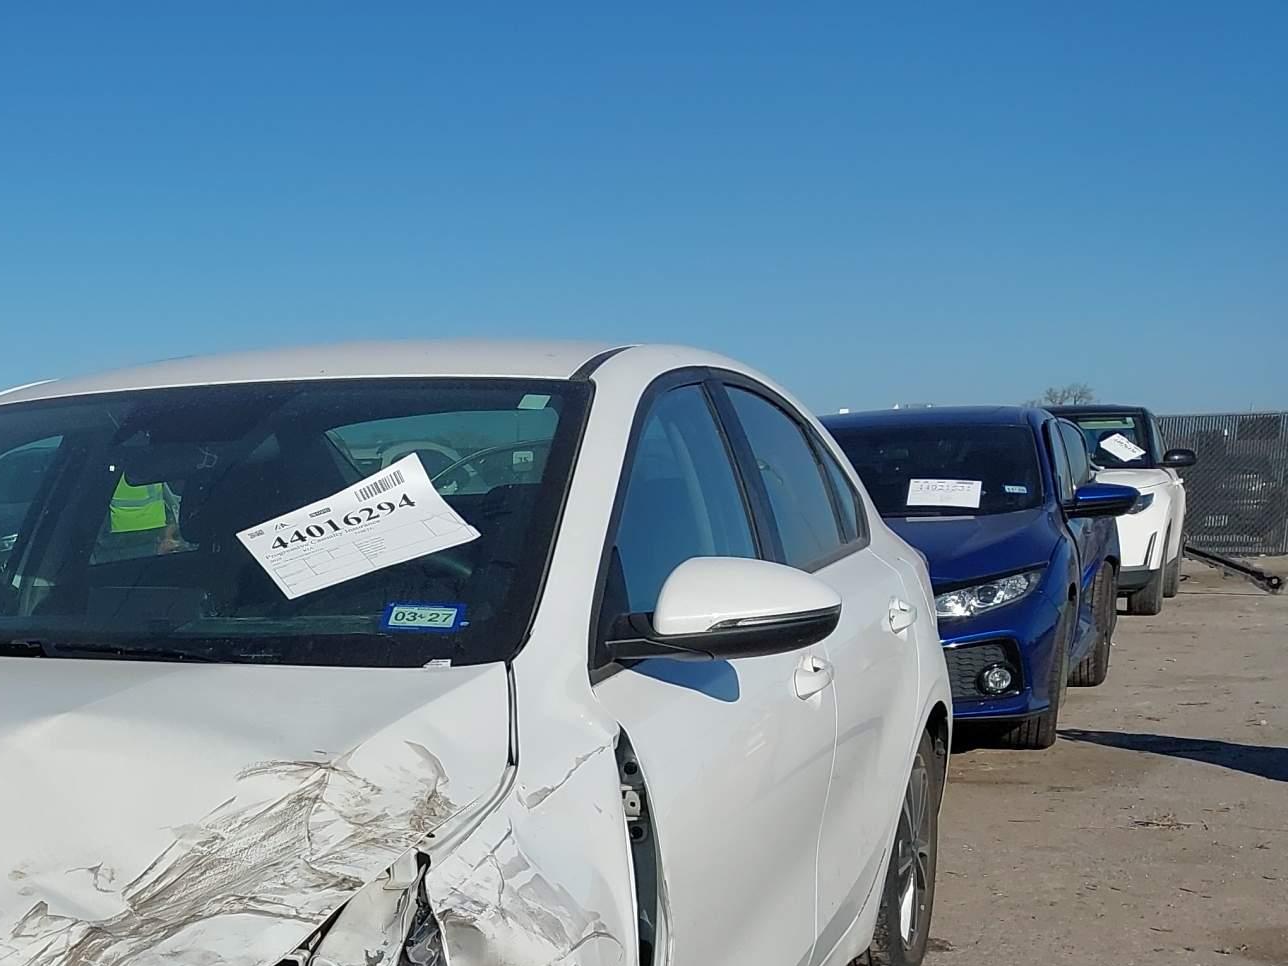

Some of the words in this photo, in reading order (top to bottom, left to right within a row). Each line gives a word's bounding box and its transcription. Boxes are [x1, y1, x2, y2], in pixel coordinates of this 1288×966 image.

[271, 492, 416, 550] 44016294
[394, 611, 418, 622] 03
[427, 612, 453, 623] 27
